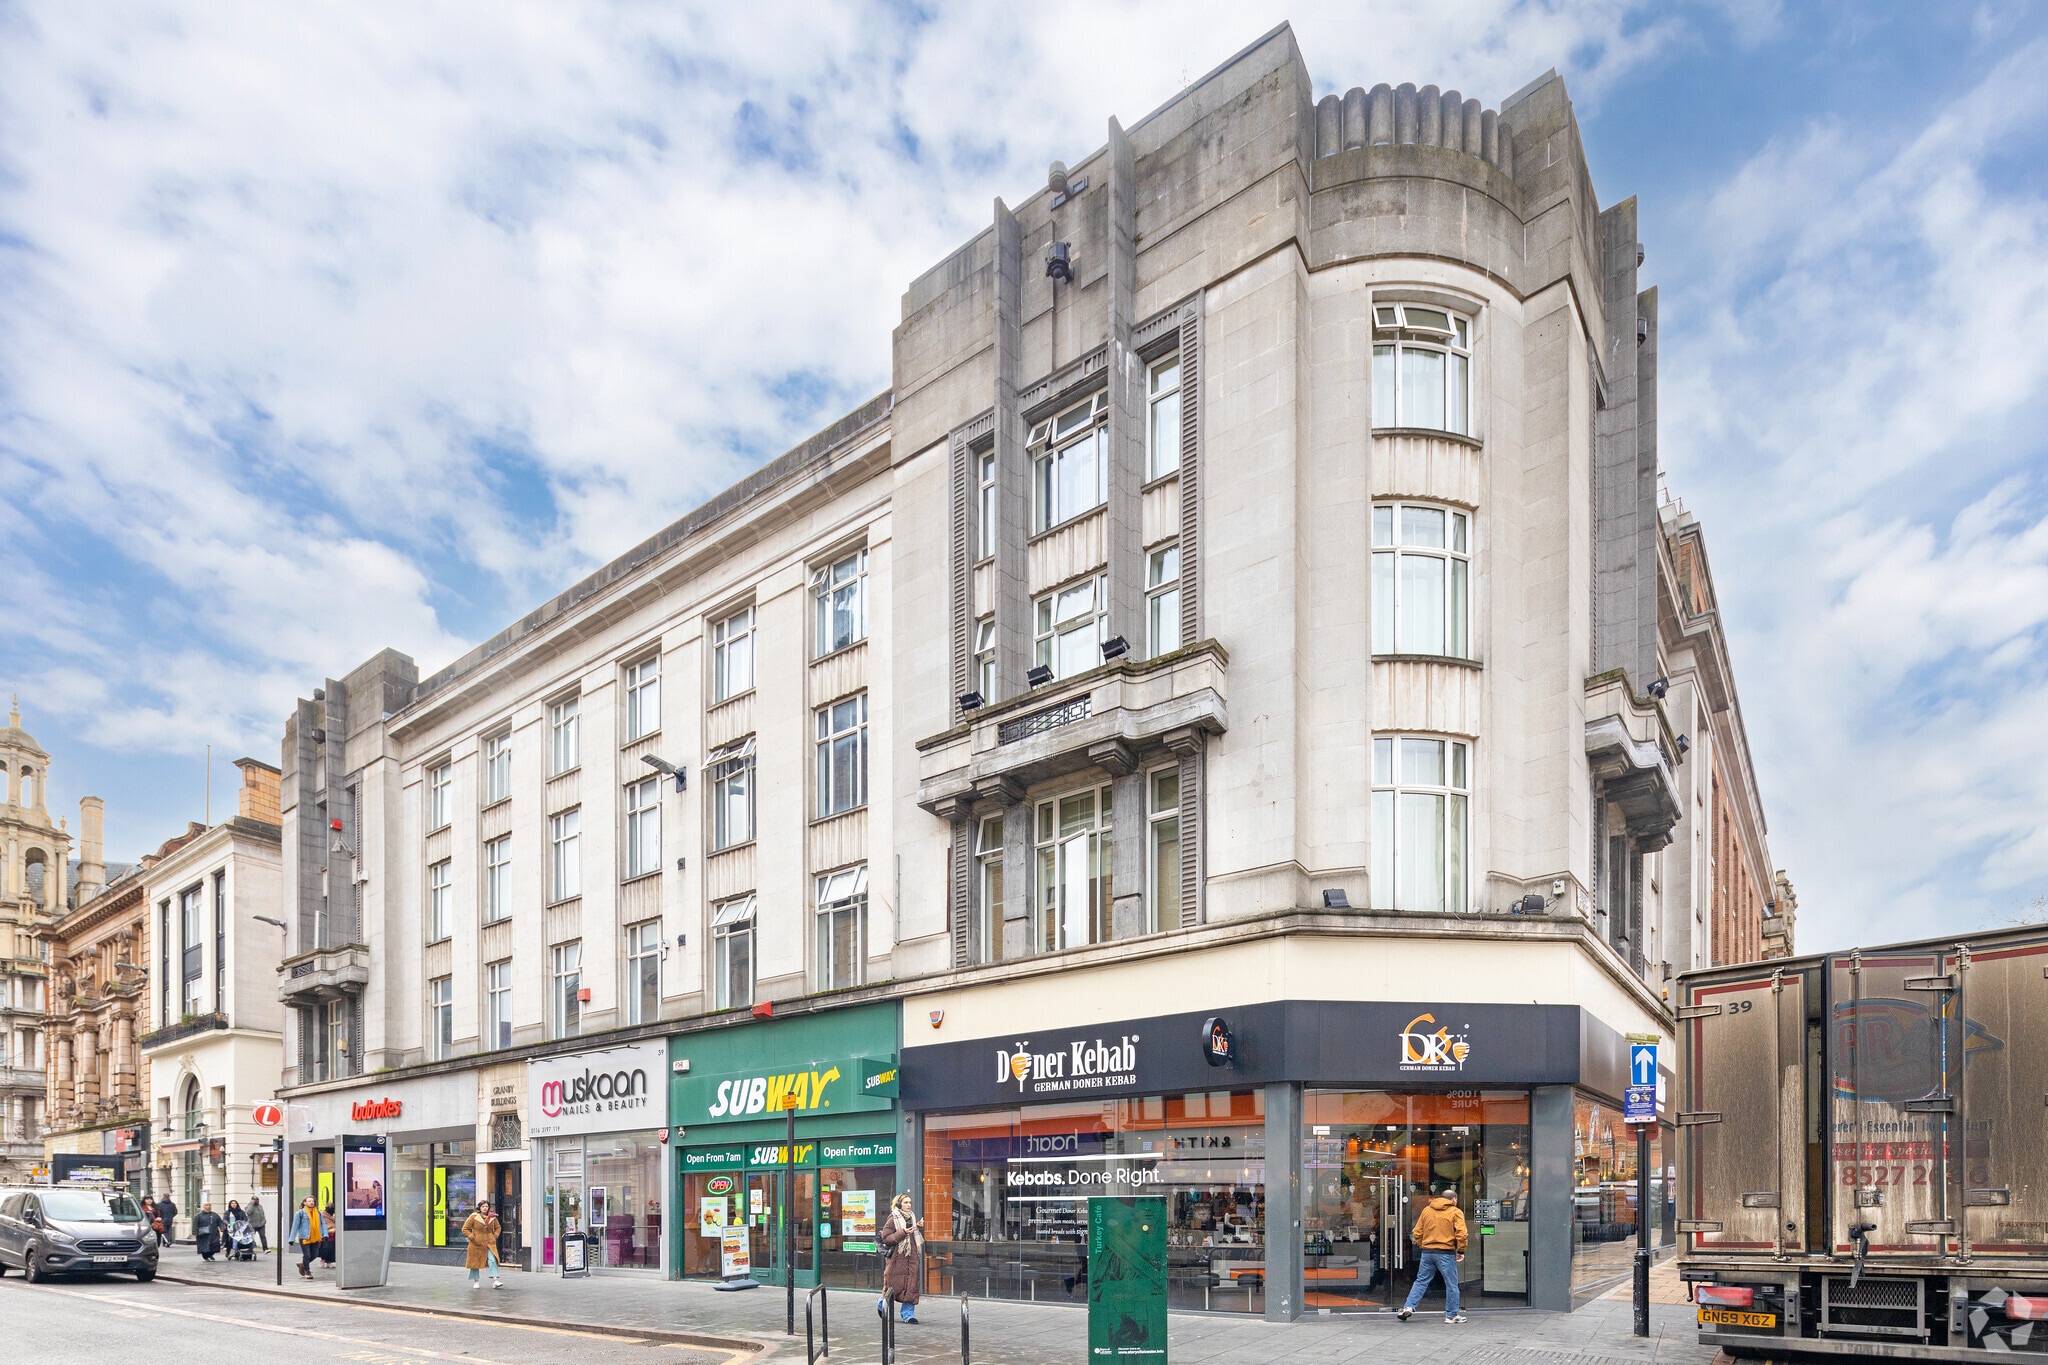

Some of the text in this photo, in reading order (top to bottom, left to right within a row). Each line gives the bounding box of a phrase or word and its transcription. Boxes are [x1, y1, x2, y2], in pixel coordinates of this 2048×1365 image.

[1728, 1000, 1753, 1015] 39
[1070, 1036, 1136, 1077] Kebab
[541, 1067, 648, 1107] muskaan
[865, 1068, 897, 1089] SUBWAY
[1034, 1074, 1137, 1093] GERMAN DONER KEBAB
[492, 1084, 515, 1096] GRANBY
[708, 1066, 841, 1119] SUBWAY
[351, 1097, 402, 1122] Ladbrokes
[491, 1096, 518, 1107] BUILDINGS
[562, 1097, 647, 1116] NAILS & BEAUTY
[262, 1106, 275, 1125] L
[1866, 1119, 1916, 1133] Essential
[686, 1152, 741, 1165] Open From 7am
[823, 1144, 893, 1159] Open From 7am
[1888, 1143, 1936, 1158] Specia
[1007, 1167, 1165, 1188] Kebabs. Done Right.
[1841, 1164, 1905, 1187] 8527
[710, 1180, 730, 1190] OPEN
[1035, 1206, 1062, 1214] Gourmet
[1027, 1216, 1052, 1227] premium
[1094, 1204, 1104, 1255] Turkey Café
[1702, 1310, 1770, 1327] GN69 XGZ
